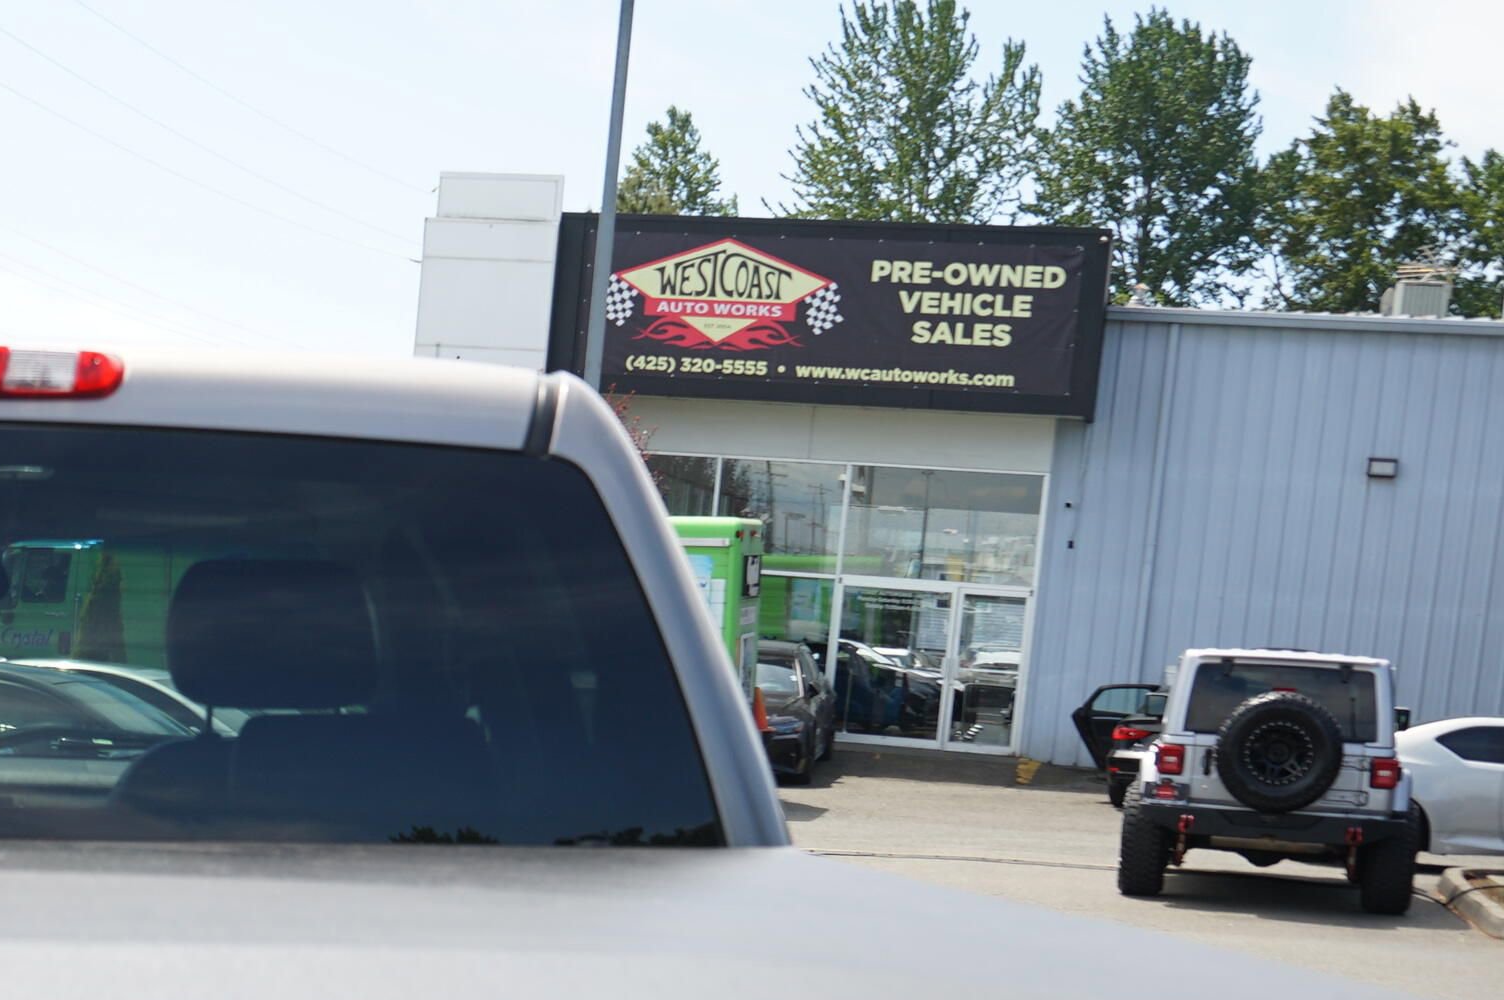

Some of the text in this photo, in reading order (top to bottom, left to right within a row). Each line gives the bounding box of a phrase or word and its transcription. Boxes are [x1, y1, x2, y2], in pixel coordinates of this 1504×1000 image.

[870, 259, 1067, 289] PRE-OWNED
[657, 300, 783, 318] AUTO WORKS
[899, 290, 1034, 318] VEHICLE
[911, 320, 1013, 348] SALES
[625, 354, 768, 376] (425) 320-5555
[796, 364, 1015, 387] www.wcautoworks.com
